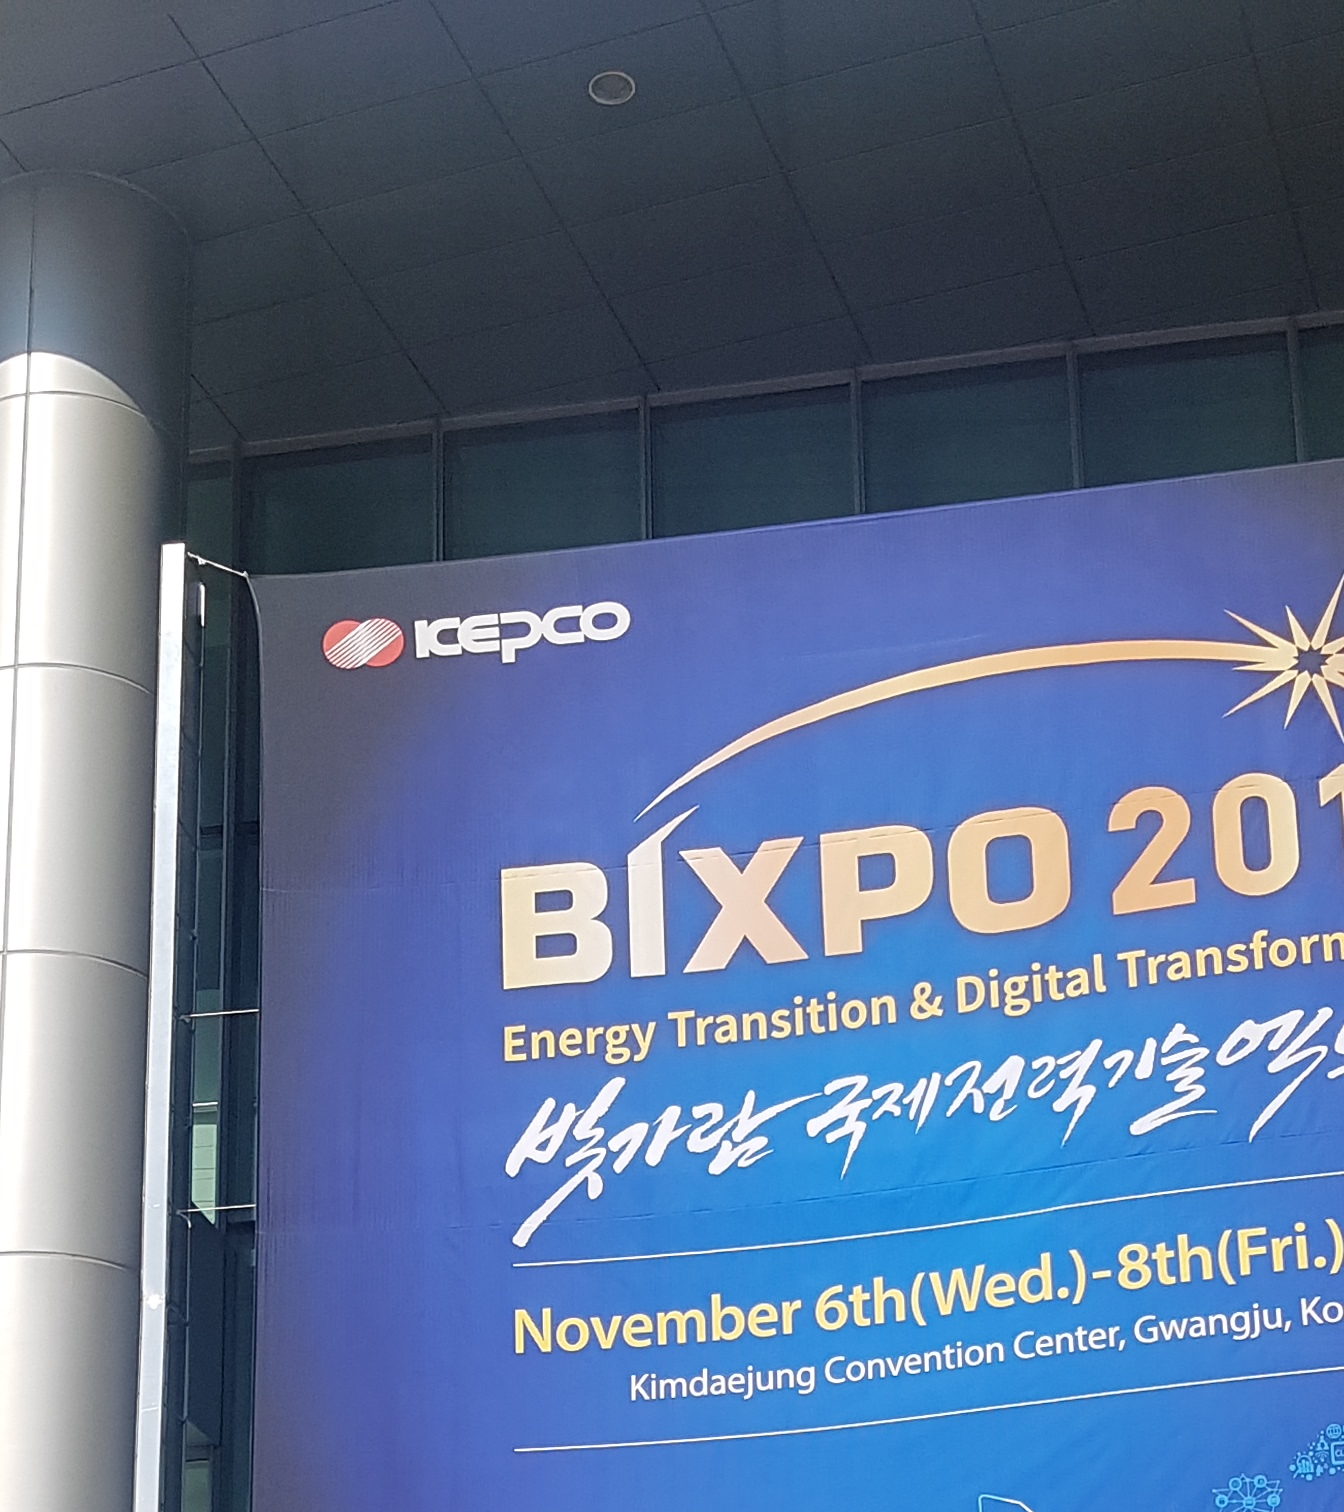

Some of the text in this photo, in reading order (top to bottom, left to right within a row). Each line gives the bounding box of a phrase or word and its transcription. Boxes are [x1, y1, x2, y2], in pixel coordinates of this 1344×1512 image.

[415, 601, 631, 663] KEPCO
[500, 805, 1072, 990] BIXPO
[503, 1020, 656, 1064] Energy
[667, 991, 897, 1048] Transition
[909, 981, 944, 1018] &
[956, 952, 1107, 1017] Digital
[513, 1293, 802, 1355] November
[629, 1363, 816, 1402] Kimdaejung
[824, 1338, 1006, 1384] Convention
[1012, 1321, 1127, 1362] Center,
[1133, 1303, 1293, 1345] Gwangju,
